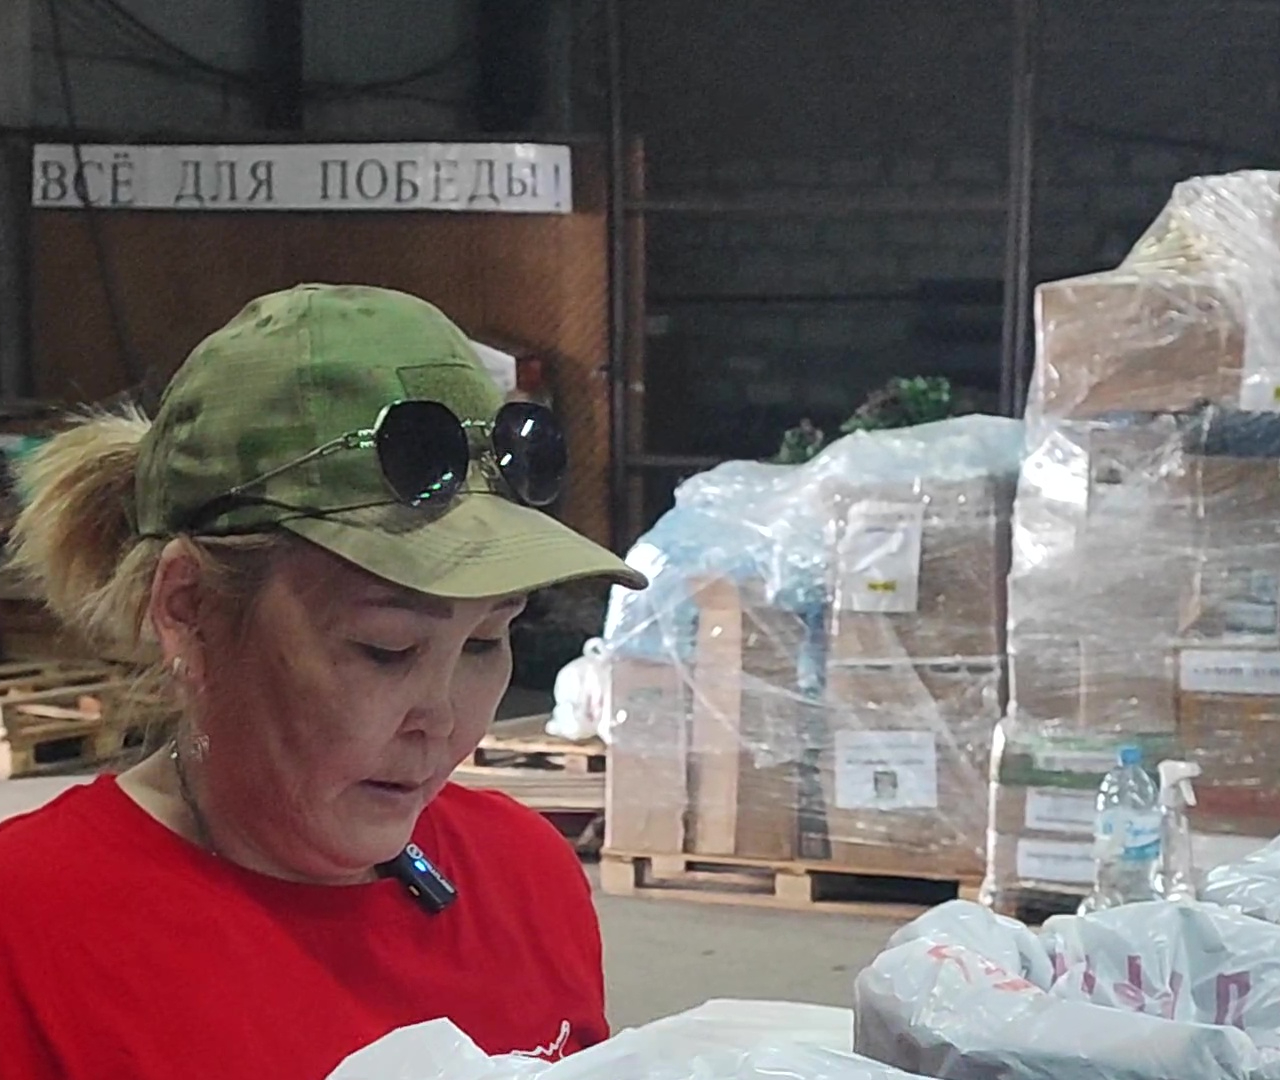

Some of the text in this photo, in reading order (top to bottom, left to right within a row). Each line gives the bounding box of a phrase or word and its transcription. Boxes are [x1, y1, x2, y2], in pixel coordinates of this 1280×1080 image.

[39, 152, 563, 209] ВСЁ ДЛЯ ПОБЕДЫ!
